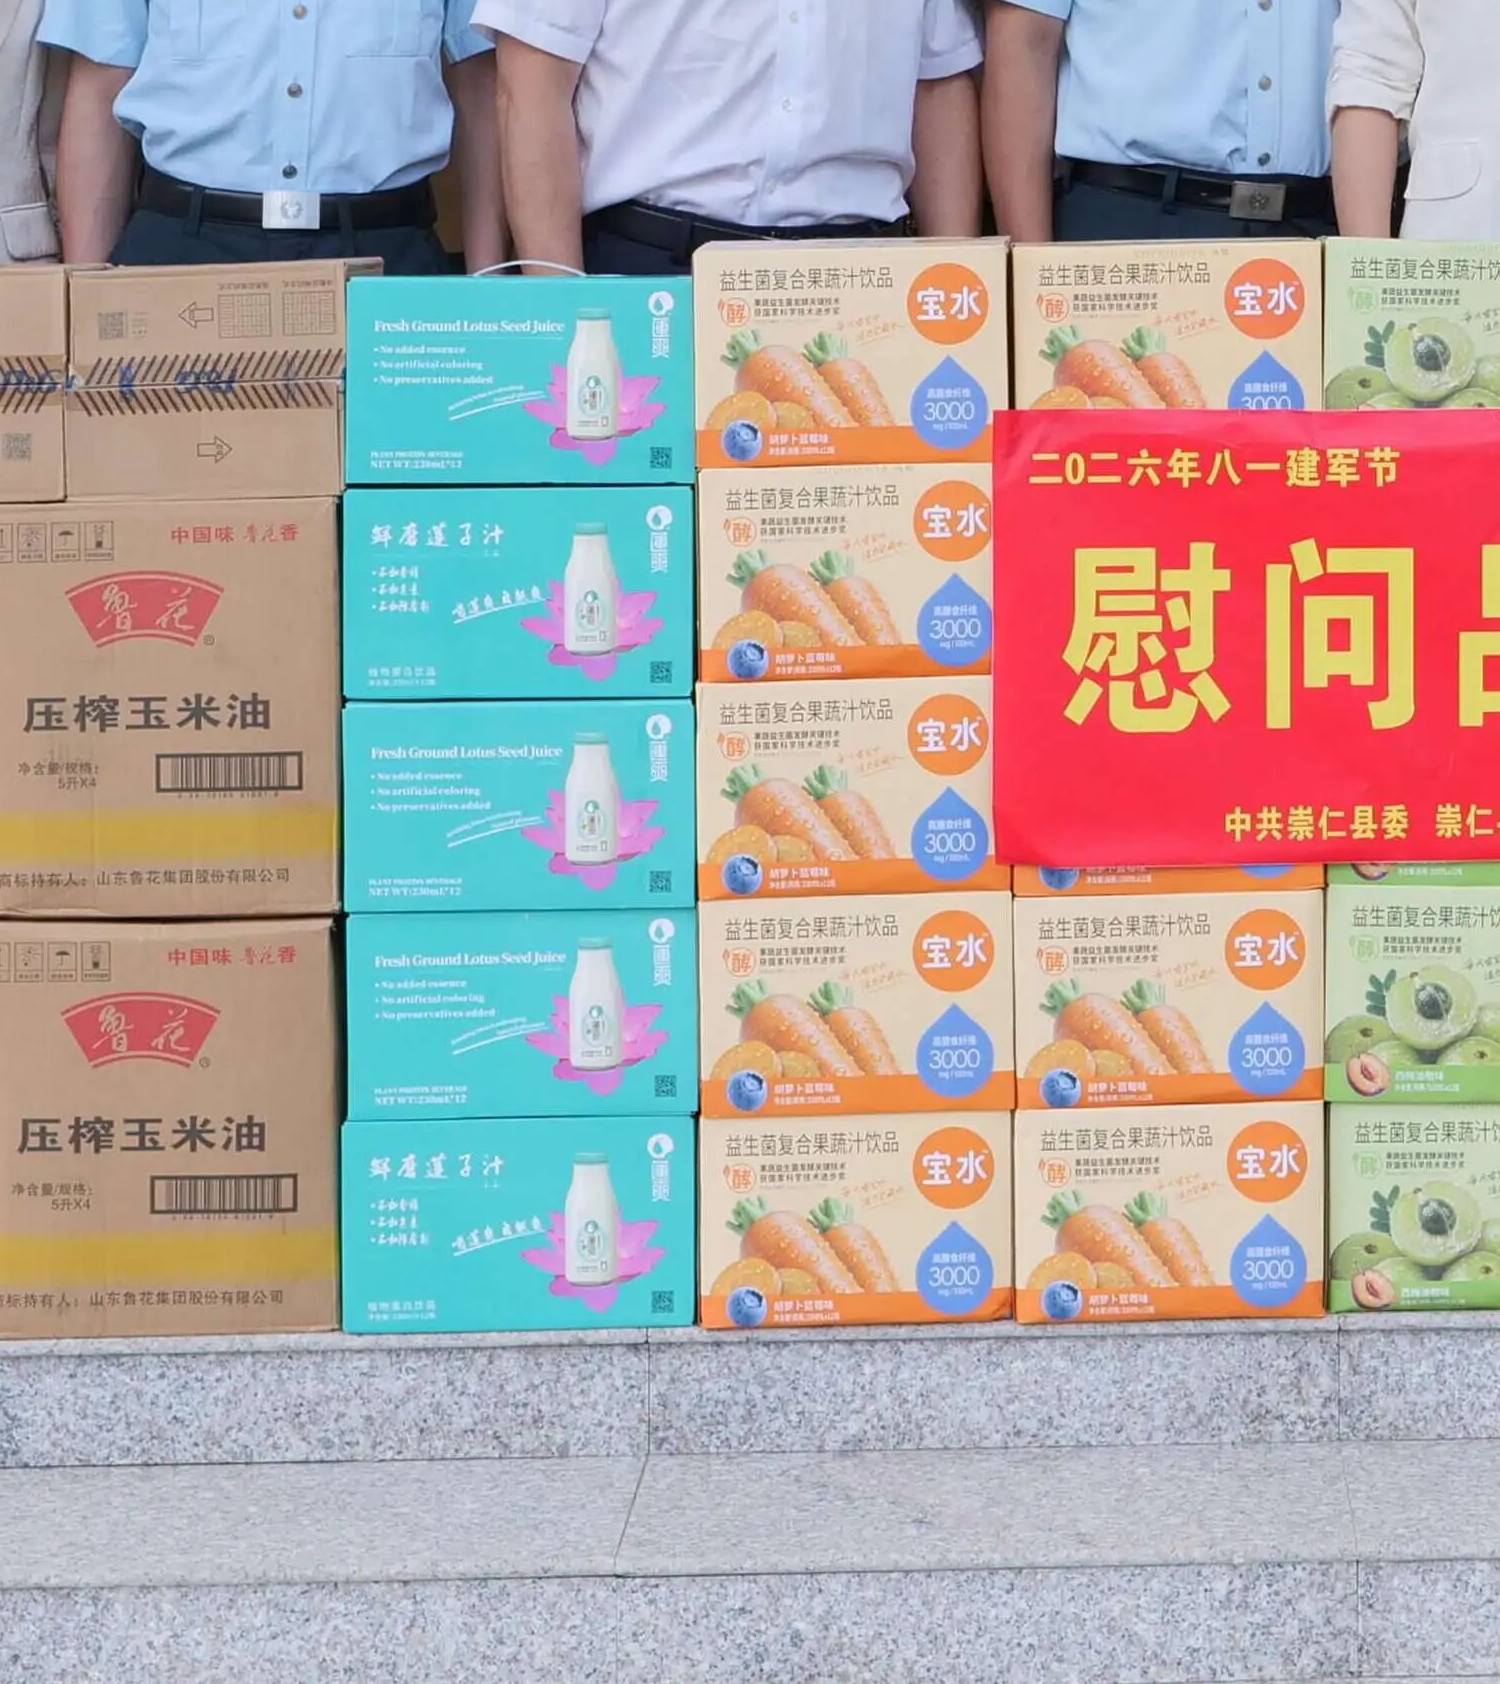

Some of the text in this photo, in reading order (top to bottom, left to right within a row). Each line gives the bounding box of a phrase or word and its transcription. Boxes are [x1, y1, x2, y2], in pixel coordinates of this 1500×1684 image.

[719, 267, 893, 291] 益生菌复合果蔬汁饮品
[1038, 263, 1211, 287] 益生菌复合果蔬汁饮品
[916, 285, 983, 321] 宝水
[1233, 281, 1299, 316] 宝水
[374, 319, 409, 333] Fresh
[411, 319, 460, 334] Ground
[463, 319, 499, 333] Lotus
[500, 319, 529, 333] Seed
[923, 400, 975, 422] 3000
[725, 485, 899, 512] 益生菌复合果蔬汁饮品
[923, 504, 988, 538] 宝水
[930, 619, 980, 640] 3000
[22, 693, 271, 733] 压榨玉米油
[1224, 804, 1409, 842] 中共崇仁县委
[725, 915, 899, 942] 益生菌复合果蔬汁饮品
[1038, 913, 1211, 940] 益生菌复合果蔬汁饮品
[921, 934, 988, 969] 宝水
[1234, 932, 1299, 967] 宝水
[1241, 1046, 1293, 1068] 3000
[18, 1114, 266, 1154] 压榨玉米油
